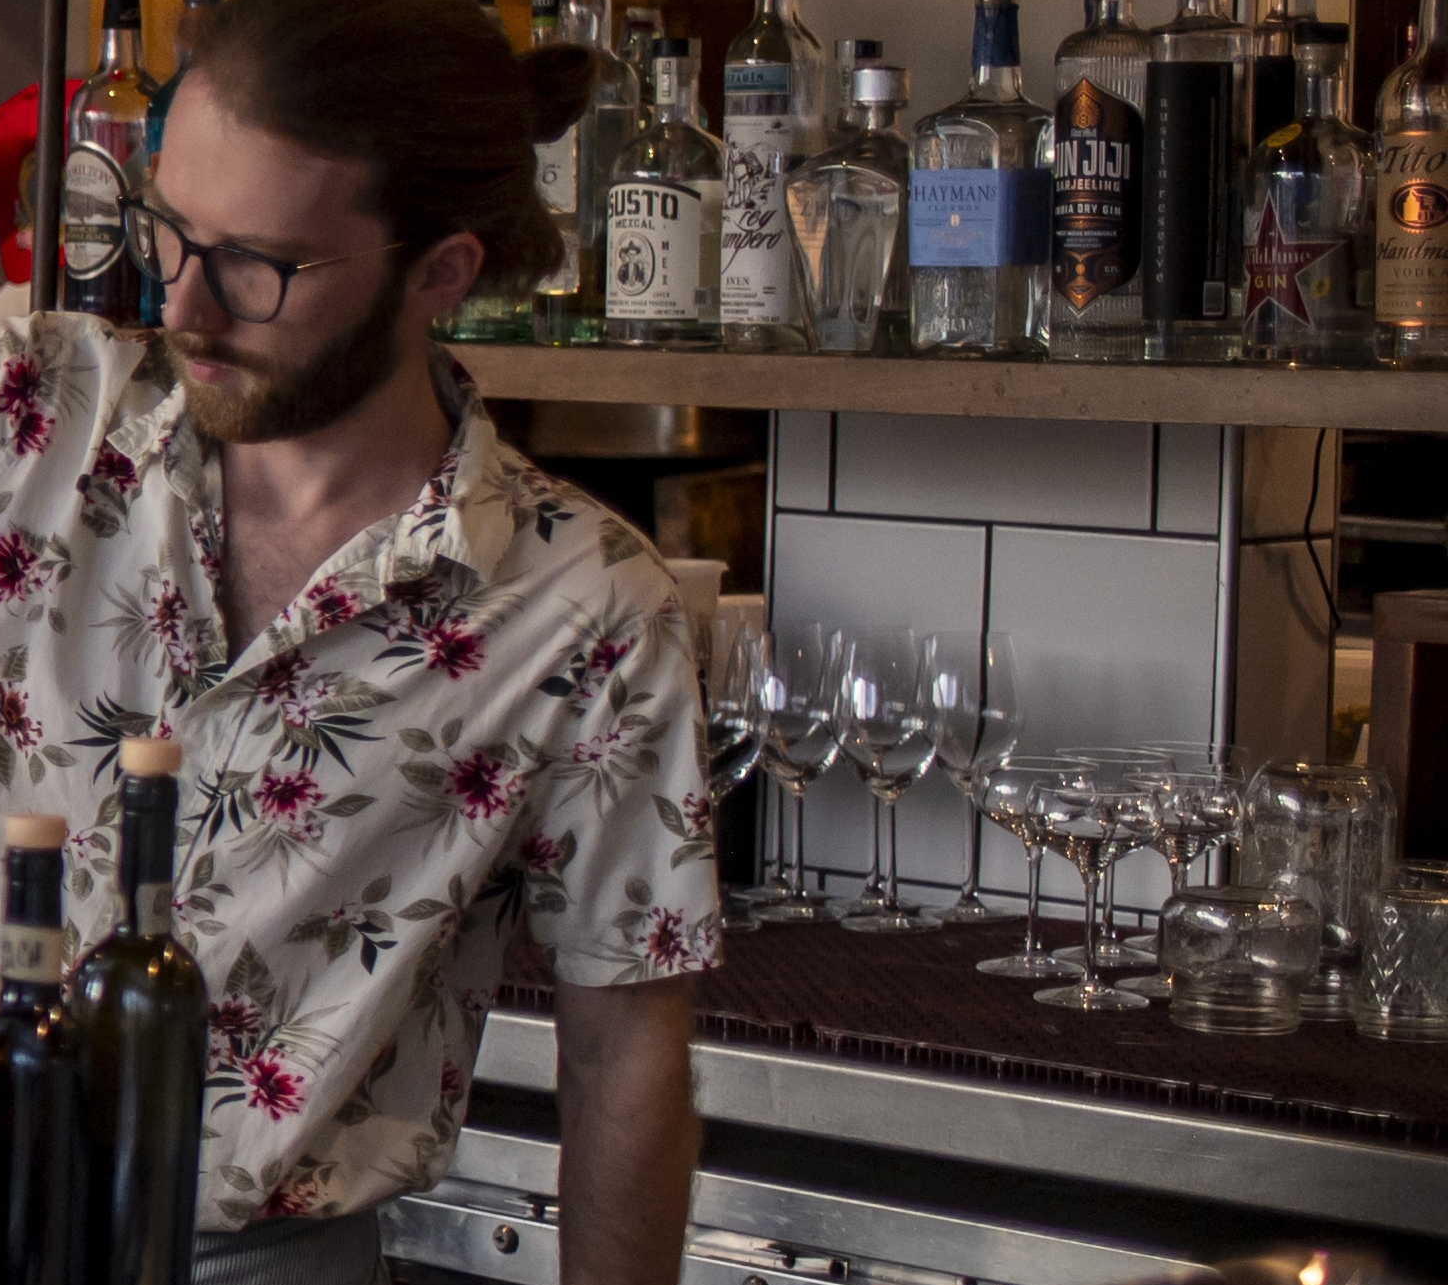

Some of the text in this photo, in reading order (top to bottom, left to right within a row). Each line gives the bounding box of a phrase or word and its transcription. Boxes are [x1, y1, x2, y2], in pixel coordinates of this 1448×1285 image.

[1083, 140, 1131, 180] JIJI
[1383, 141, 1448, 175] Tito
[1077, 203, 1098, 215] DRY
[1102, 204, 1121, 216] GIN
[616, 220, 655, 230] MEZCAL
[1377, 237, 1448, 259] Handma
[1254, 276, 1288, 289] GIN
